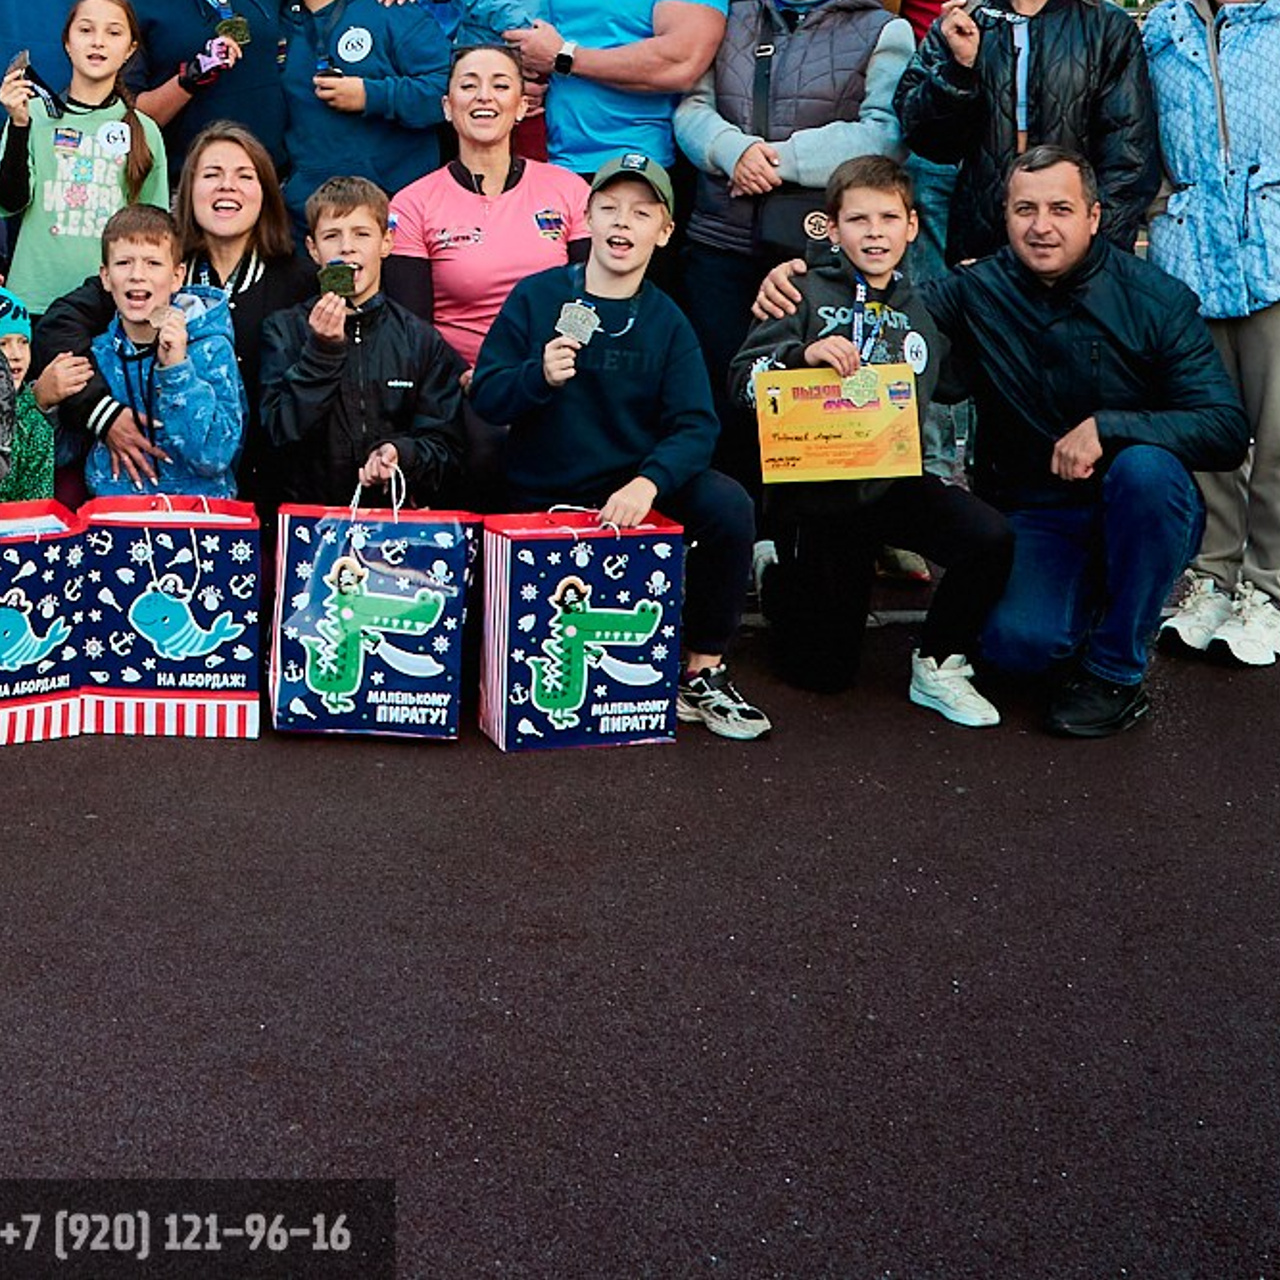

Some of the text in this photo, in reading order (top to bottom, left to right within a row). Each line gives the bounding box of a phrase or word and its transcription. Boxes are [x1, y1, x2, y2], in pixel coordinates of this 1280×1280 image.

[345, 37, 365, 52] 68
[11, 673, 70, 696] АБОРДАЖ!
[156, 672, 247, 689] НА АБОРДАЖ!
[366, 690, 452, 707] МАЛЕНЬКОМУ
[375, 705, 448, 726] ПИРАТУ!
[591, 699, 670, 717] МАЛЕНЬКОМУ
[599, 714, 666, 734] ПИРАТУ!
